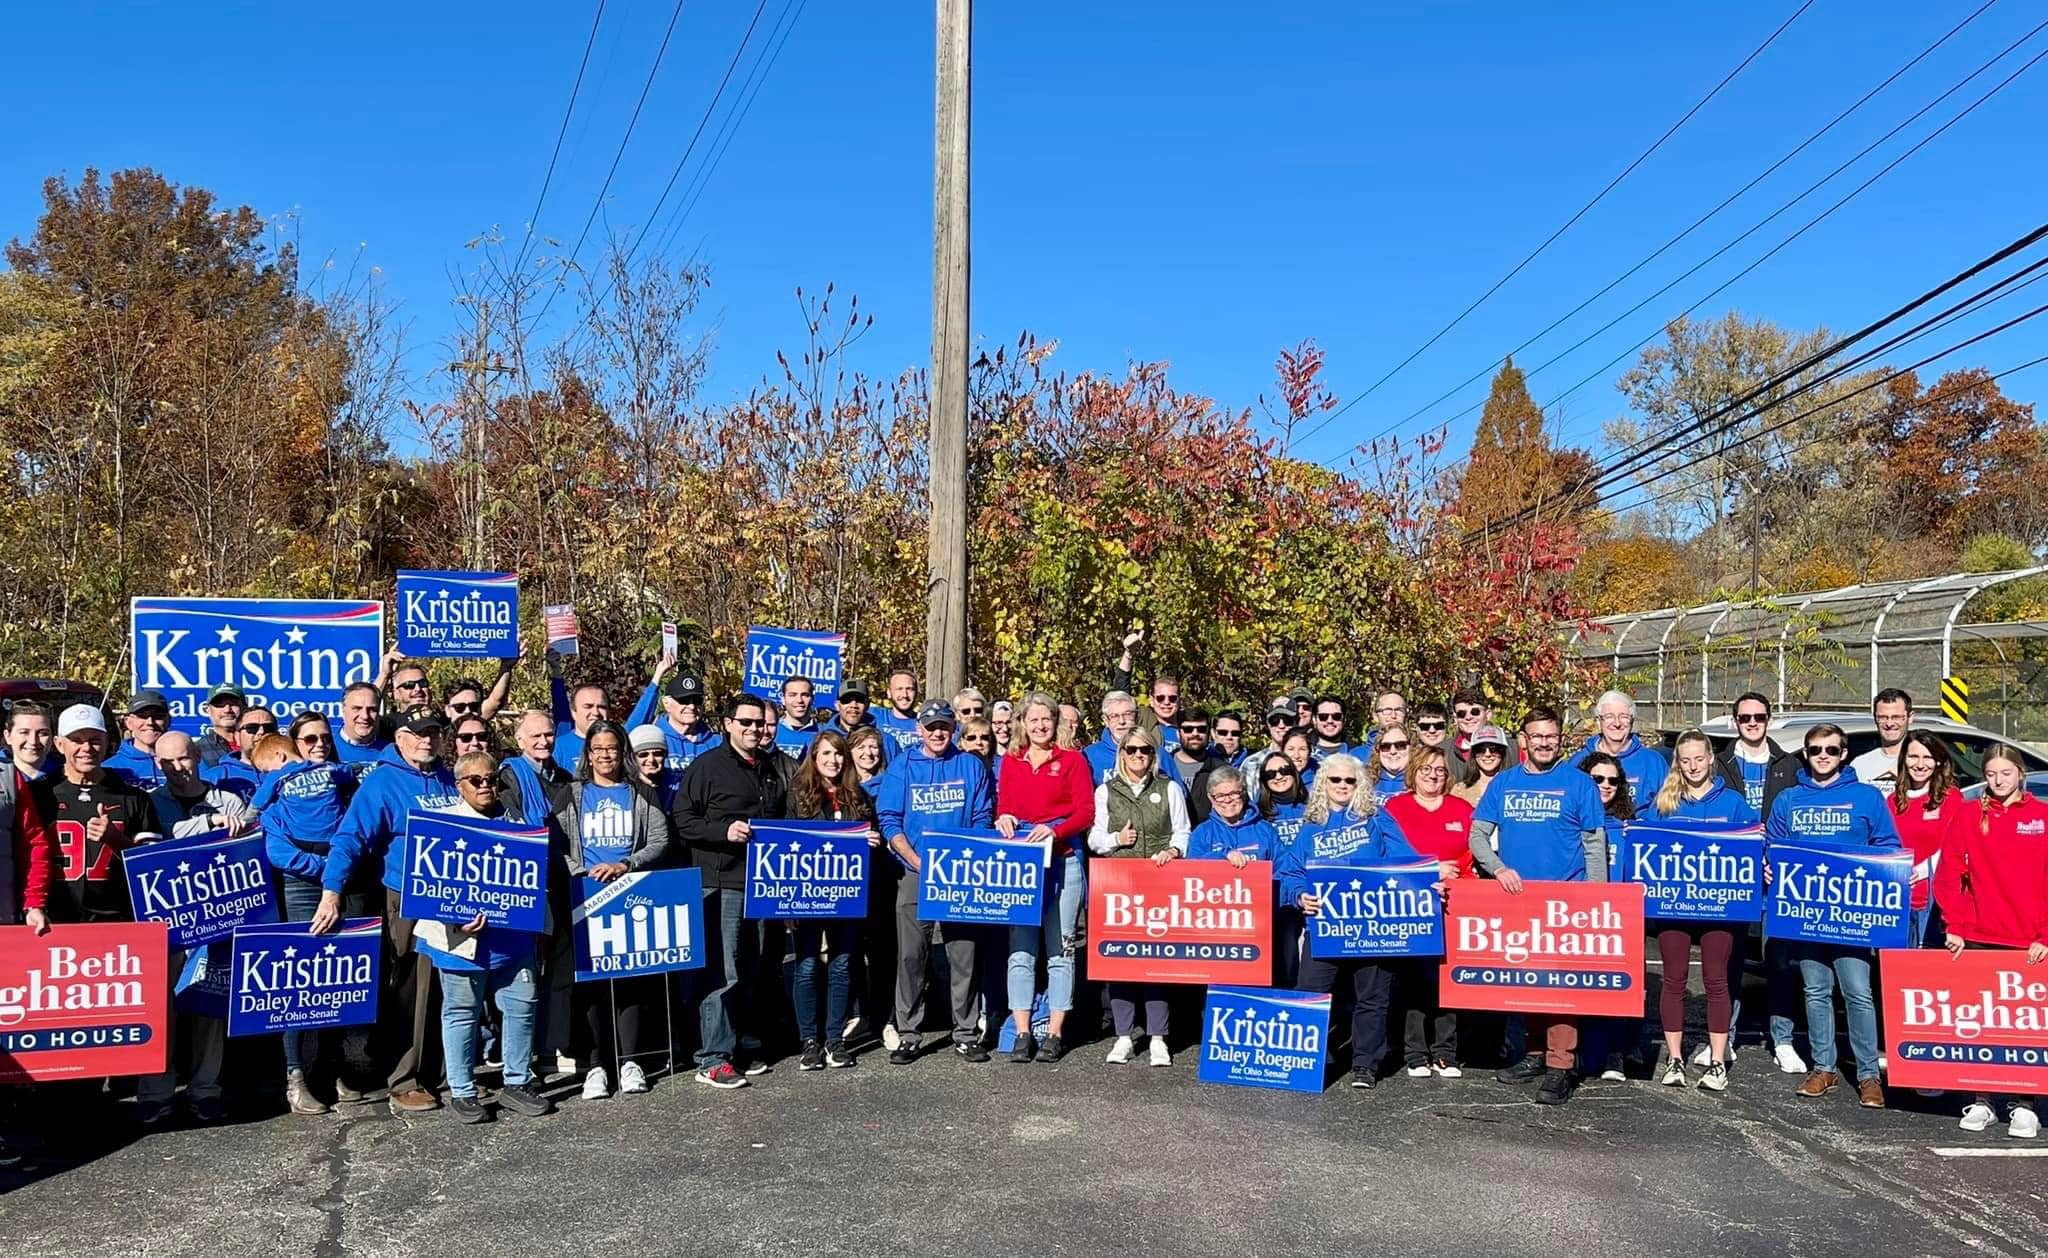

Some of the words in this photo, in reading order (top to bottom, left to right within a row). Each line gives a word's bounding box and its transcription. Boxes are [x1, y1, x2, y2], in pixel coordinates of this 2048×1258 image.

[404, 588, 511, 624] Kristina
[407, 624, 448, 641] Daley
[453, 625, 510, 641] Roegner
[431, 641, 442, 649] for
[443, 641, 461, 649] Ohio
[140, 624, 372, 690] Kristina
[750, 644, 836, 680] Kristina
[750, 674, 784, 691] Daley
[169, 694, 210, 717] ale
[912, 785, 965, 803] Kristina
[1504, 792, 1561, 811] Kristina
[583, 808, 633, 837] Hill
[1792, 808, 1850, 825] Kristina
[596, 836, 633, 847] JUDGE
[1313, 827, 1370, 849] Kristina
[411, 835, 539, 890] Kristina
[753, 841, 863, 881] Kristina
[925, 847, 1037, 889] Kristina
[1631, 841, 1756, 884] Kristina
[137, 852, 266, 915] Kristina
[412, 879, 463, 904] Daley
[467, 885, 537, 910] Roegner
[585, 876, 634, 912] MAGISTRATE
[754, 882, 798, 901] Daley
[801, 882, 861, 901] Roegner
[1184, 877, 1252, 905] Beth
[1686, 883, 1753, 904] Roegner
[1776, 861, 1903, 910] Kristina
[203, 892, 267, 920] Roegner
[440, 903, 454, 912] for
[455, 904, 477, 915] Ohio
[779, 901, 789, 909] for
[791, 901, 810, 909] Ohio
[926, 885, 969, 905] Daley
[973, 888, 1035, 909] Roegner
[950, 904, 961, 913] for
[962, 905, 981, 914] Ohio
[983, 907, 1009, 916] Senate
[1312, 877, 1436, 920] Kristina
[1661, 902, 1672, 910] for
[1675, 903, 1696, 911] Ohio
[1698, 903, 1725, 912] Senate
[1104, 893, 1256, 938] Bigham
[1545, 900, 1622, 929] Beth
[1776, 901, 1824, 924] Daley
[1829, 905, 1900, 929] Roegner
[181, 929, 194, 940] for
[196, 924, 216, 936] Ohio
[218, 917, 245, 930] Senate
[588, 904, 690, 957] Hill
[1317, 921, 1363, 940] Daley
[1368, 921, 1434, 939] Roegner
[1456, 916, 1626, 964] Bigham
[1803, 922, 1816, 932] for
[1818, 923, 1839, 933] Ohio
[1841, 926, 1870, 937] Senate
[1104, 943, 1122, 955] for
[1126, 944, 1176, 957] OHIO
[1185, 945, 1252, 959] HOUSE
[1344, 939, 1356, 948] for
[1358, 939, 1378, 948] Ohio
[1380, 939, 1407, 948] Senate
[48, 944, 143, 979] Beth
[238, 943, 372, 993] Kristina
[592, 955, 622, 973] FOR
[625, 947, 692, 970] JUDGE
[1457, 970, 1478, 983] for
[1482, 970, 1538, 985] OHIO
[1549, 971, 1622, 988] HOUSE
[1996, 970, 2048, 1001] Be
[0, 969, 145, 1025] gham
[240, 992, 292, 1013] Daley
[298, 990, 369, 1008] Roegner
[270, 1013, 283, 1023] for
[285, 1012, 307, 1022] Ohio
[310, 1009, 339, 1019] Senate
[1900, 988, 2048, 1039] Bigha
[8, 1034, 37, 1049] IO
[51, 1028, 141, 1046] HOUSE
[1208, 1007, 1319, 1053] Kristina
[1208, 1045, 1251, 1067] Daley
[1254, 1049, 1316, 1071] Roegner
[1905, 1044, 1926, 1058] for
[1932, 1046, 1993, 1061] OHIO
[1231, 1065, 1242, 1074] for
[1243, 1067, 1262, 1076] Ohio
[1264, 1068, 1289, 1079] Senate
